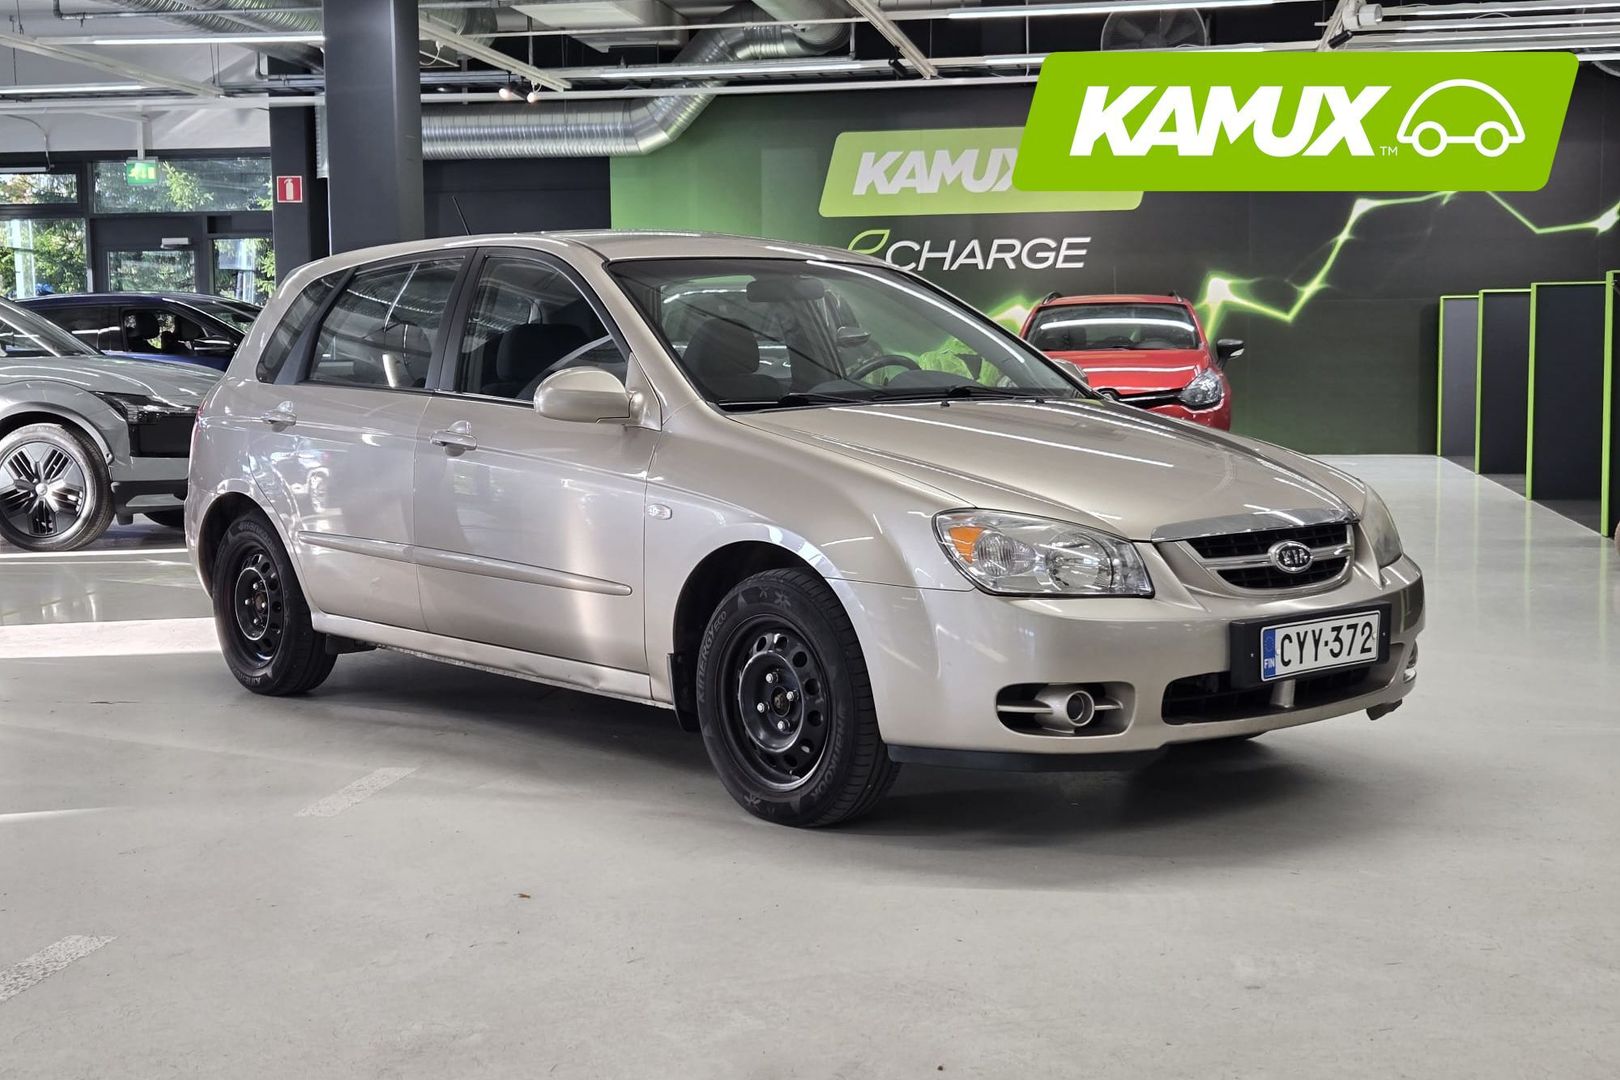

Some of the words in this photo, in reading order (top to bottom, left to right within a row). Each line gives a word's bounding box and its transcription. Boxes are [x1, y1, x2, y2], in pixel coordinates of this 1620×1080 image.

[885, 236, 1092, 272] CHARGE
[1282, 549, 1308, 567] KIA
[1279, 621, 1373, 667] CYY-372
[1264, 657, 1276, 670] FIN
